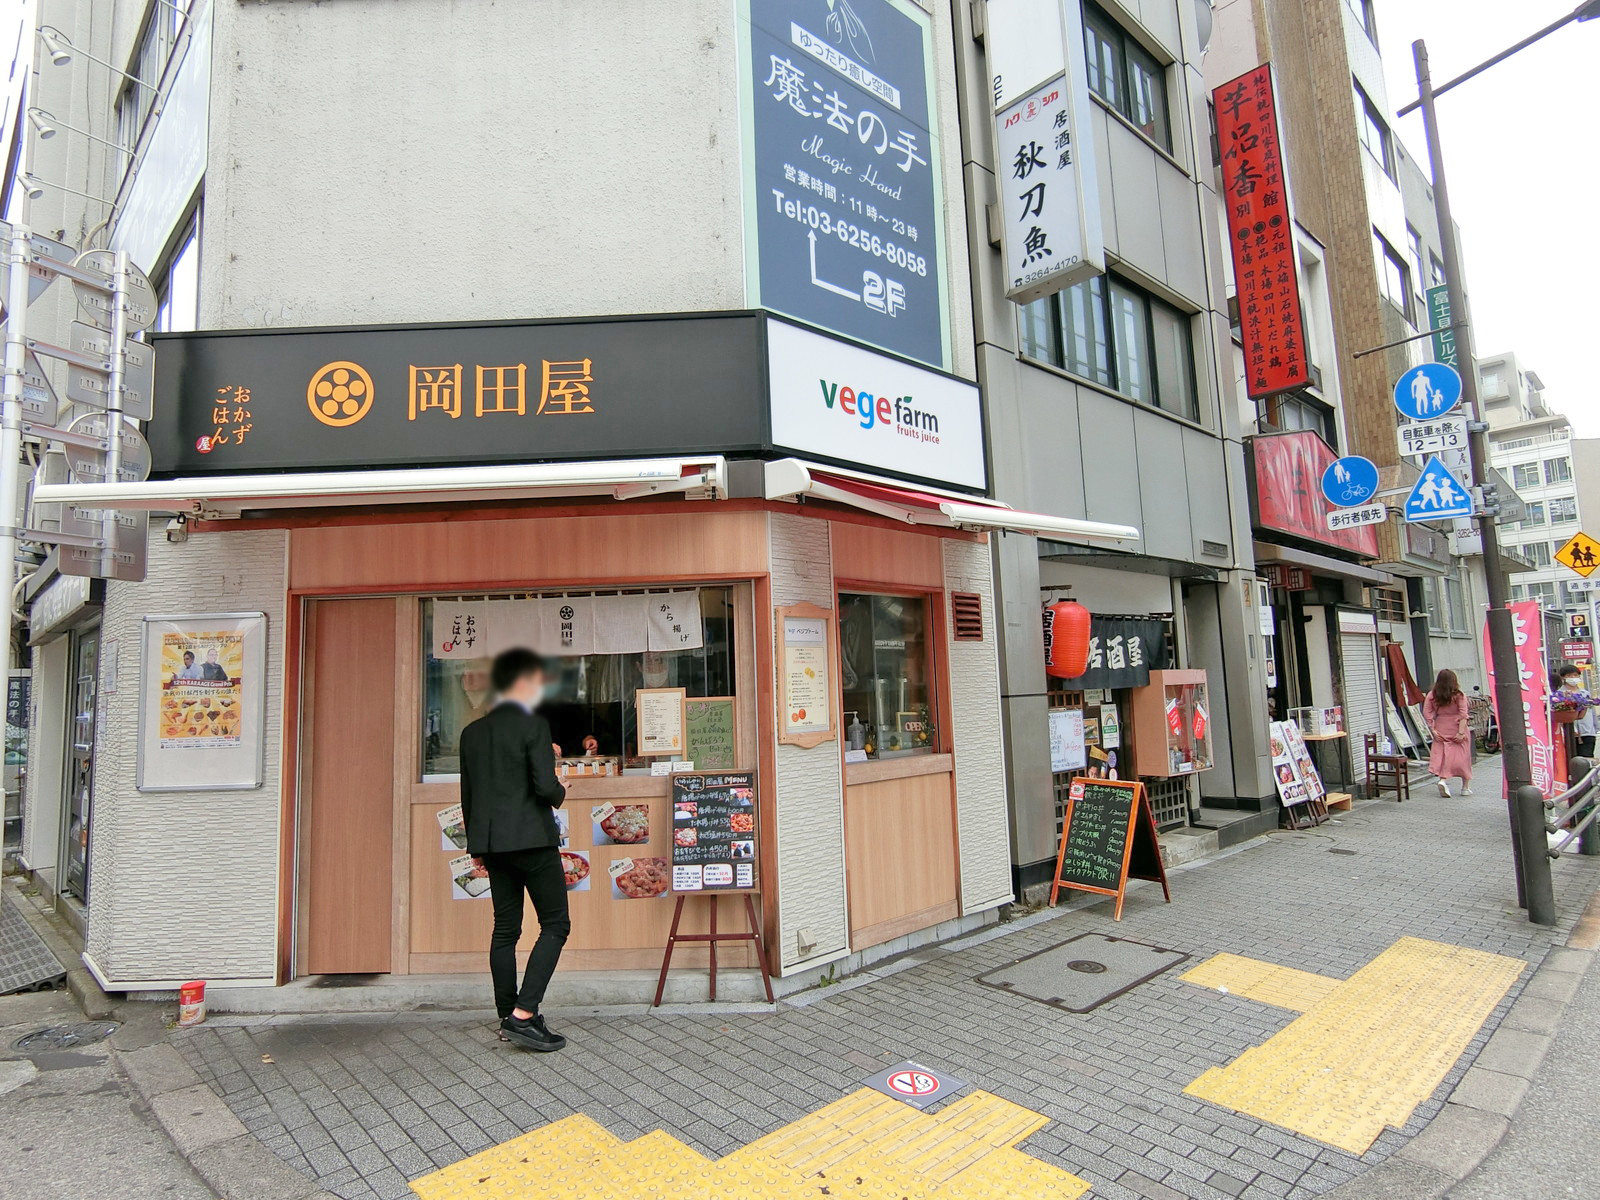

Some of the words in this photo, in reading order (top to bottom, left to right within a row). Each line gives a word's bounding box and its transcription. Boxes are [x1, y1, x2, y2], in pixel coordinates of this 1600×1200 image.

[799, 30, 894, 103] ゆったり癒し空間
[763, 54, 927, 173] 魔法の手
[1052, 109, 1072, 171] 居酒屋
[801, 134, 852, 174] Magic
[858, 164, 902, 201] Hand
[1012, 140, 1053, 269] 秋刀魚
[771, 188, 927, 277] Tel:03-6256-8058
[862, 270, 906, 318] 2F
[1024, 255, 1078, 284] 3264-4170
[211, 385, 233, 444] ごはん
[232, 385, 253, 445] おかず
[407, 357, 597, 421] 岡田屋
[896, 424, 920, 439] fruits
[921, 429, 940, 445] juice
[1402, 422, 1461, 440] 自転車を除く
[1331, 508, 1381, 527] 歩行者優先
[452, 614, 463, 646] ごはん
[465, 615, 476, 649] おかず
[659, 603, 690, 642] から揚げ
[8, 681, 22, 718] 魔法の手
